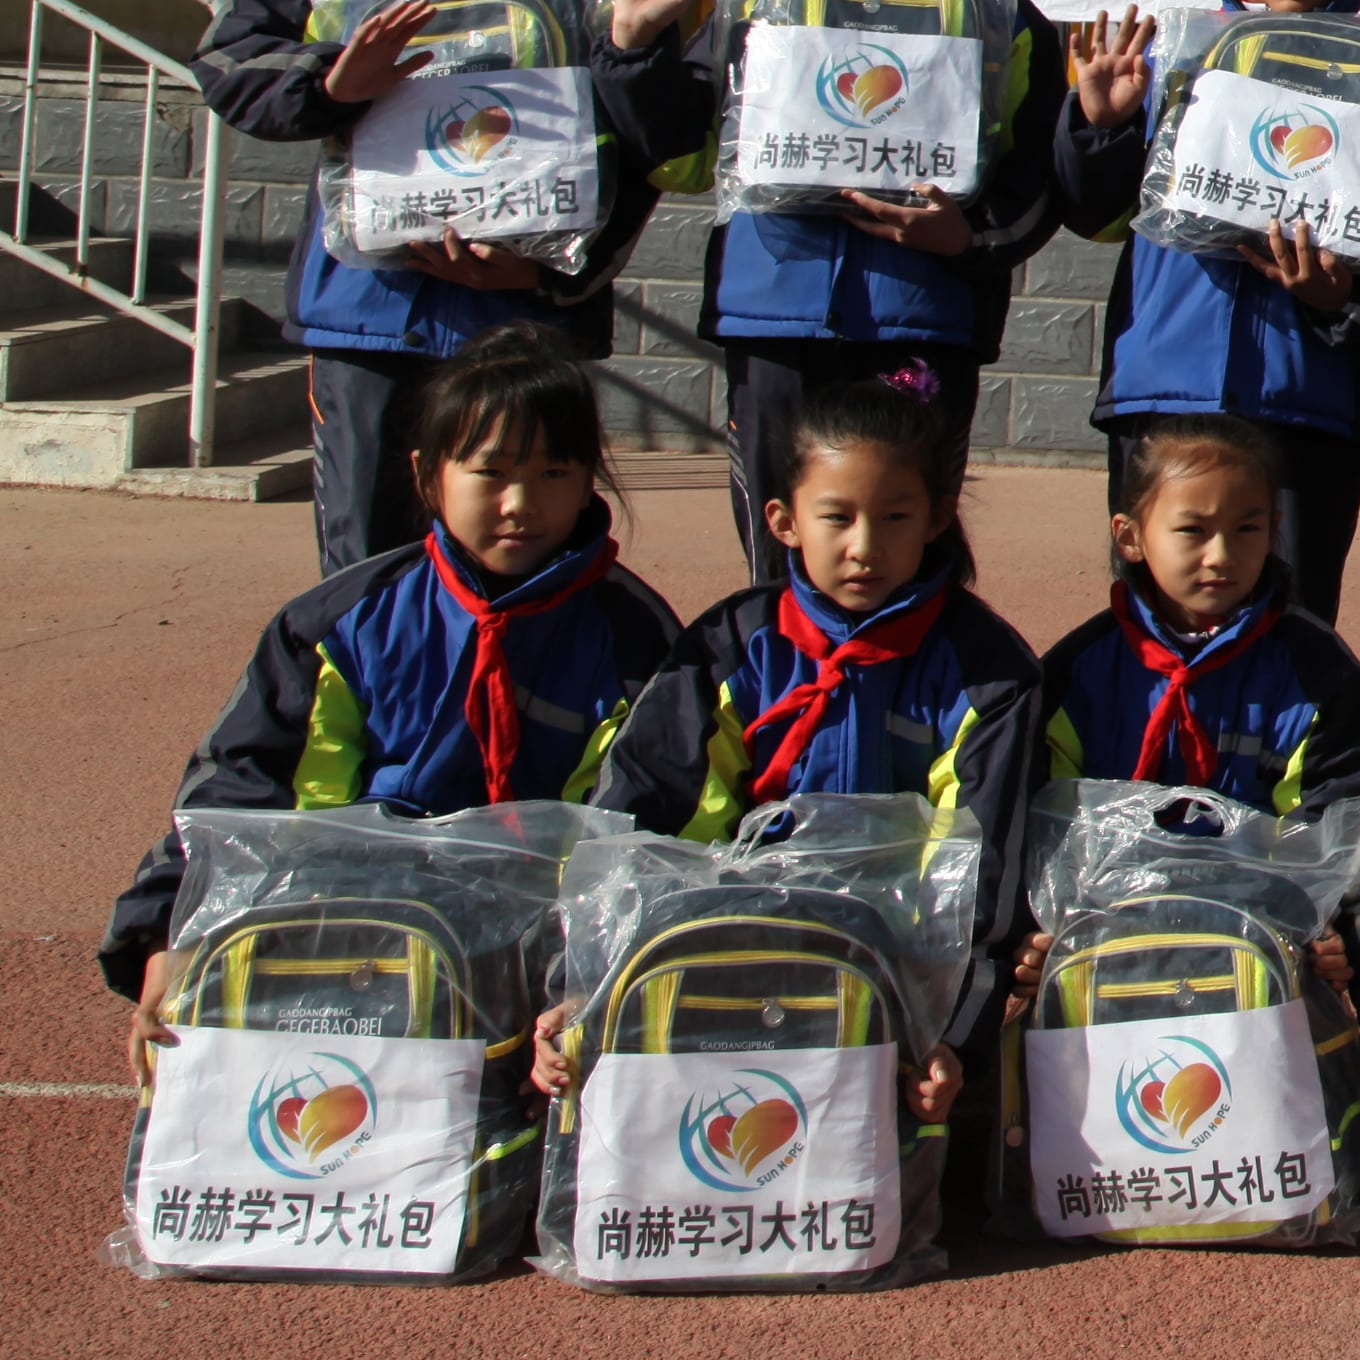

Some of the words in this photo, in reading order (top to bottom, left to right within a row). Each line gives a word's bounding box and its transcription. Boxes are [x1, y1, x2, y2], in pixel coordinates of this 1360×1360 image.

[754, 133, 956, 178] 尚赫学习大礼包
[275, 1016, 382, 1036] GEGEBAOBEI
[1191, 1129, 1212, 1148] SUN
[1209, 1103, 1230, 1131] HOPE
[319, 1158, 344, 1176] SUN
[756, 1168, 780, 1187] SUN
[778, 1141, 805, 1171] HOPE
[1057, 1150, 1312, 1220] 尚赫学习大礼包
[153, 1184, 434, 1249] 尚赫学习大礼包
[597, 1198, 877, 1261] 尚赫学习大礼包
